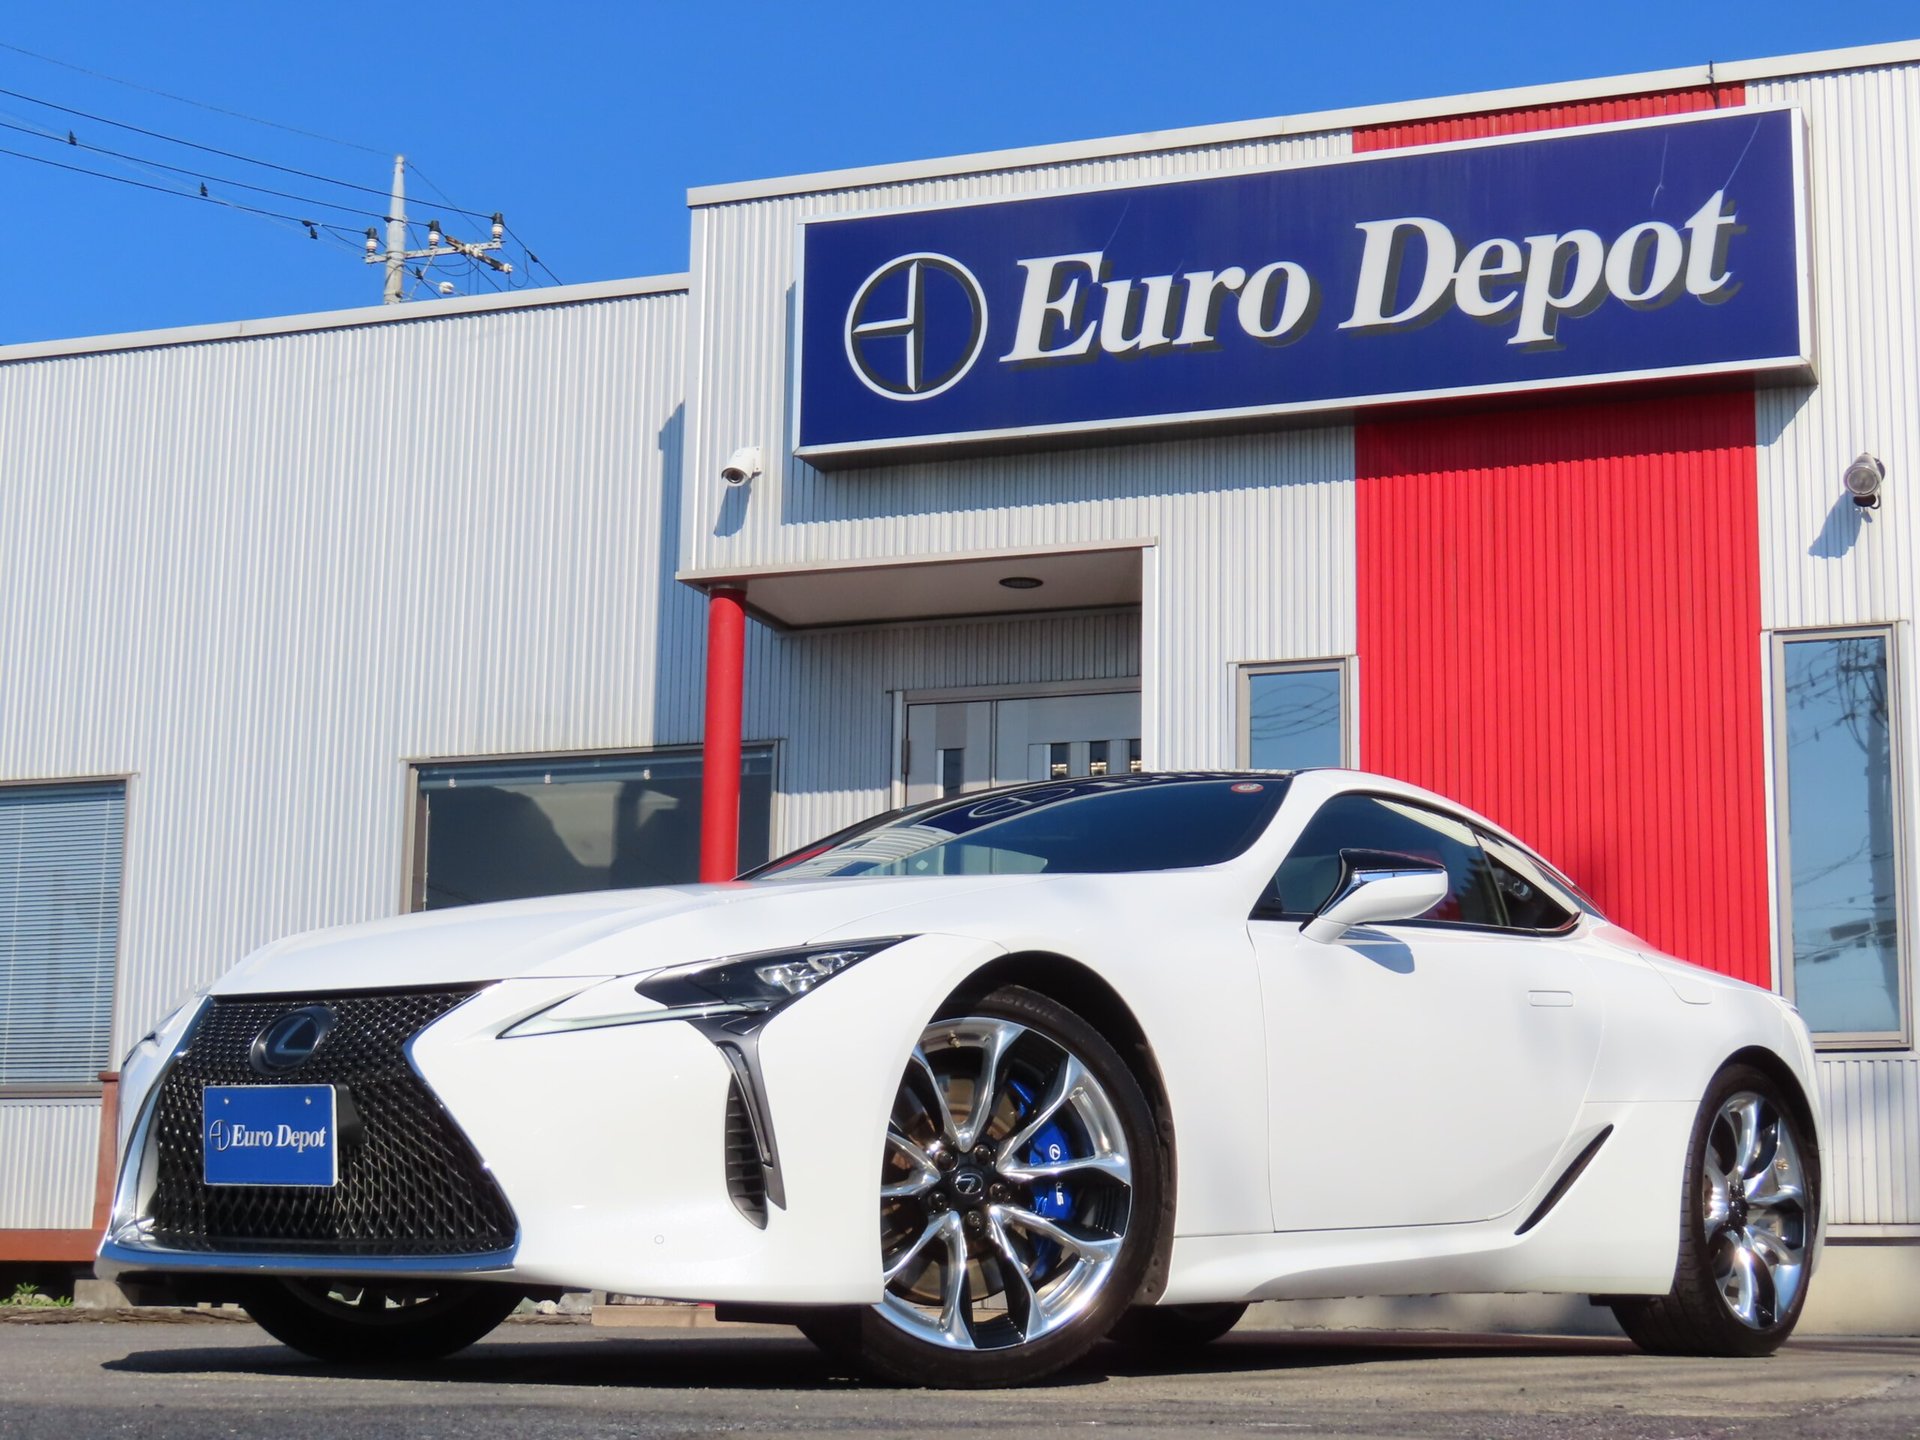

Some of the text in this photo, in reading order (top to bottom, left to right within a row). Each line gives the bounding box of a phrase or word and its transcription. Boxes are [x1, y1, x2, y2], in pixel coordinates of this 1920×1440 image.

[999, 190, 1736, 362] Euro Depot
[231, 1124, 326, 1153] Euro Depot
